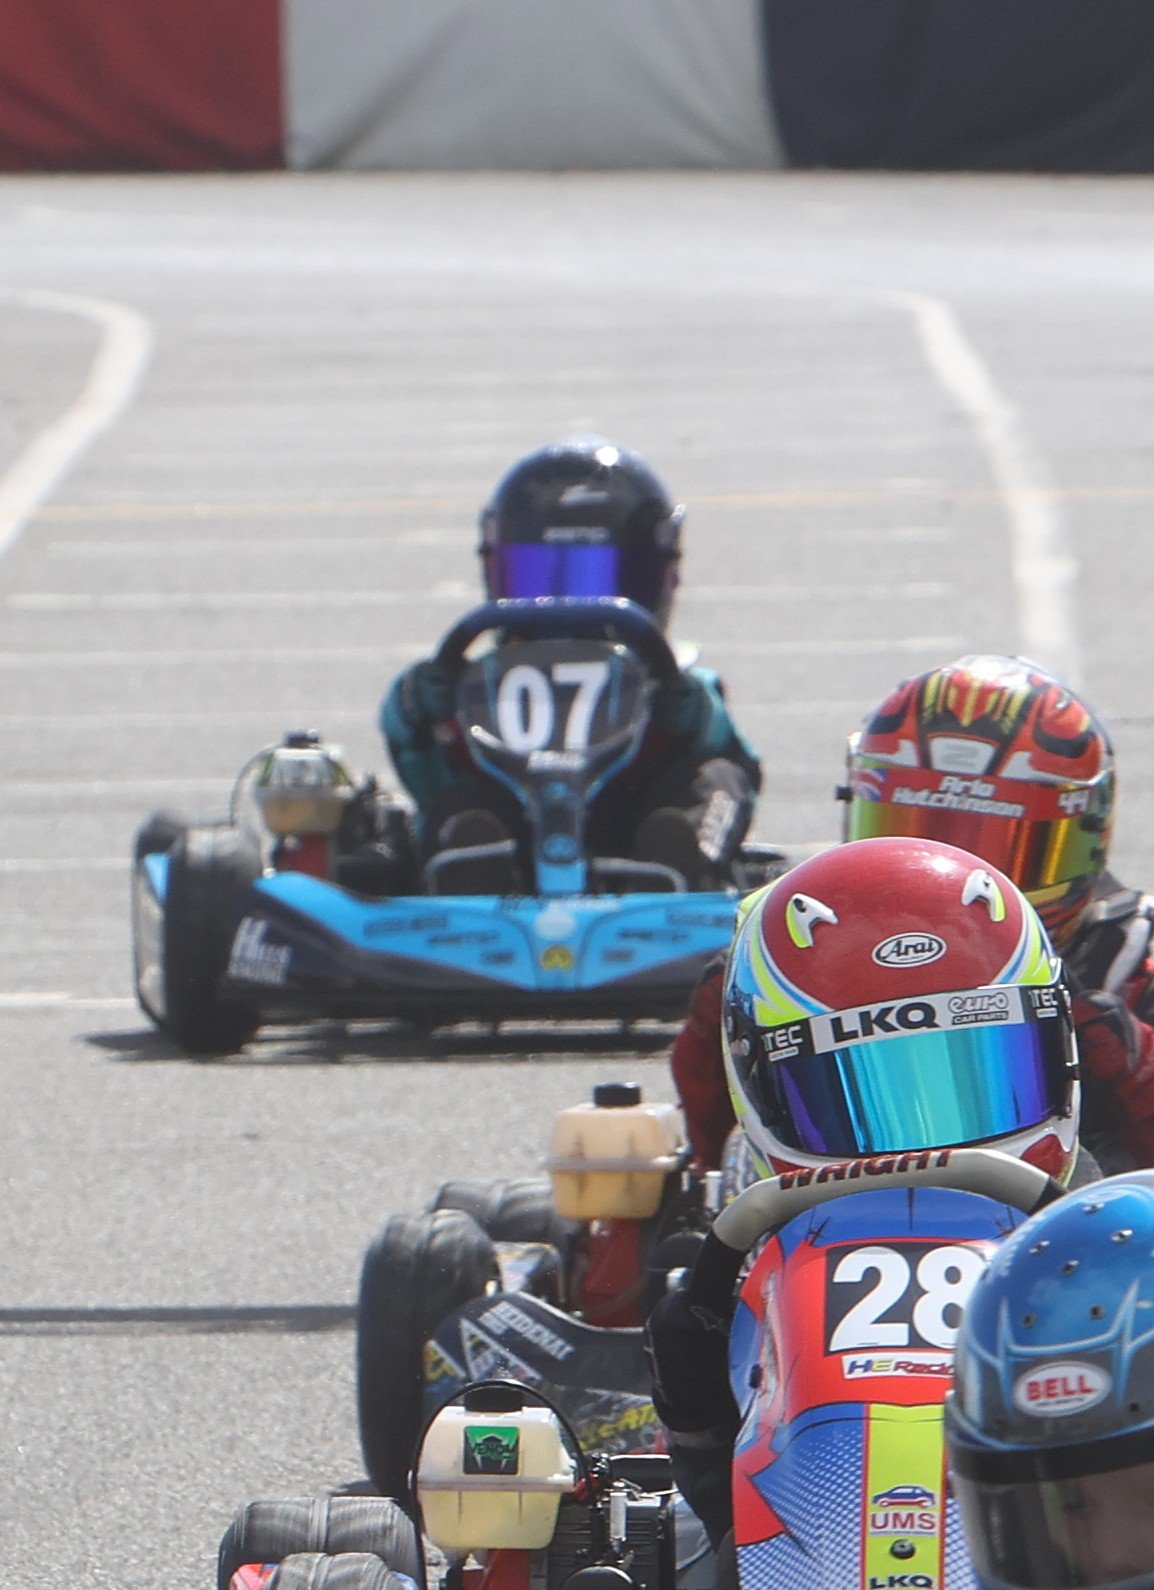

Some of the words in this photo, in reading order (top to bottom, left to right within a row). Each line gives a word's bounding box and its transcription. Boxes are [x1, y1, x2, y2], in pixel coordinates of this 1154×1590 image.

[497, 661, 609, 757] 07
[882, 940, 936, 960] Arai
[949, 991, 1009, 1015] euro
[830, 1002, 942, 1044] LKQ
[953, 1013, 977, 1025] CAR
[978, 1011, 1009, 1022] PARTS
[828, 1245, 987, 1352] 28
[1026, 1374, 1096, 1402] BELL
[870, 1511, 936, 1530] UMS
[869, 1575, 934, 1590] LKQ
